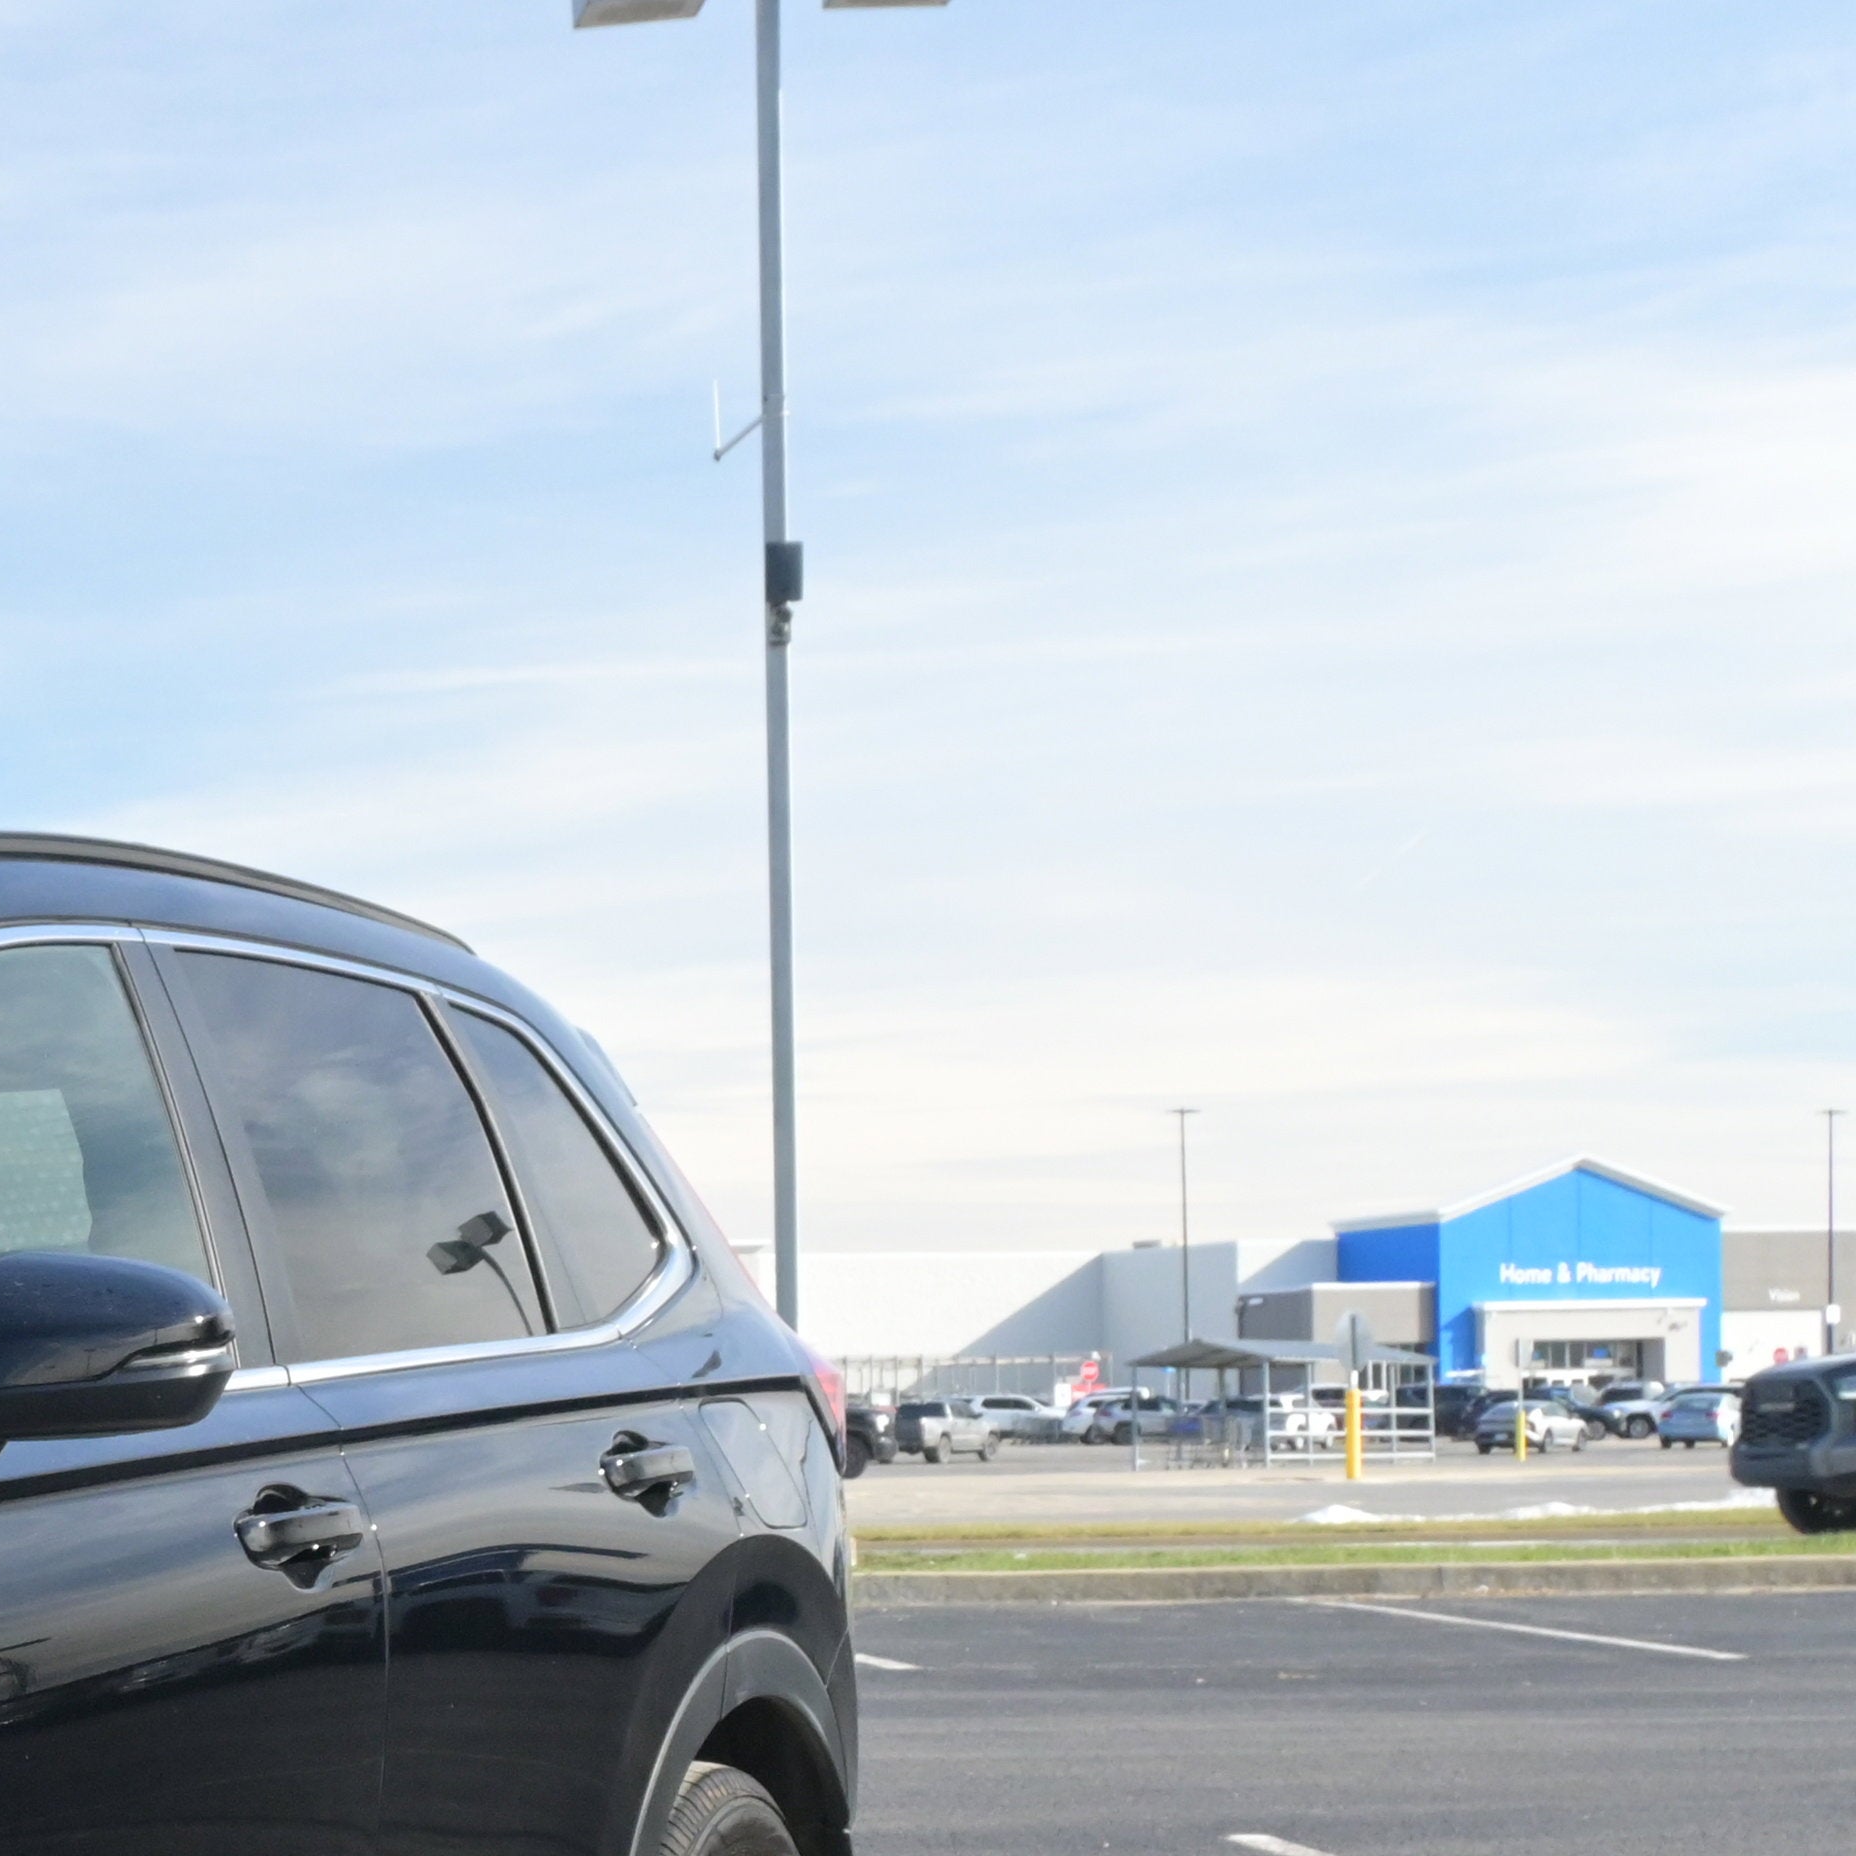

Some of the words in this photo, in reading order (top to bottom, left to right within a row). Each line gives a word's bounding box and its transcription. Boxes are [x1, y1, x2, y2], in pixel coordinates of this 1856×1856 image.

[1500, 1263, 1553, 1284] Home
[1557, 1262, 1572, 1284] &
[1576, 1262, 1662, 1290] Pharmacy
